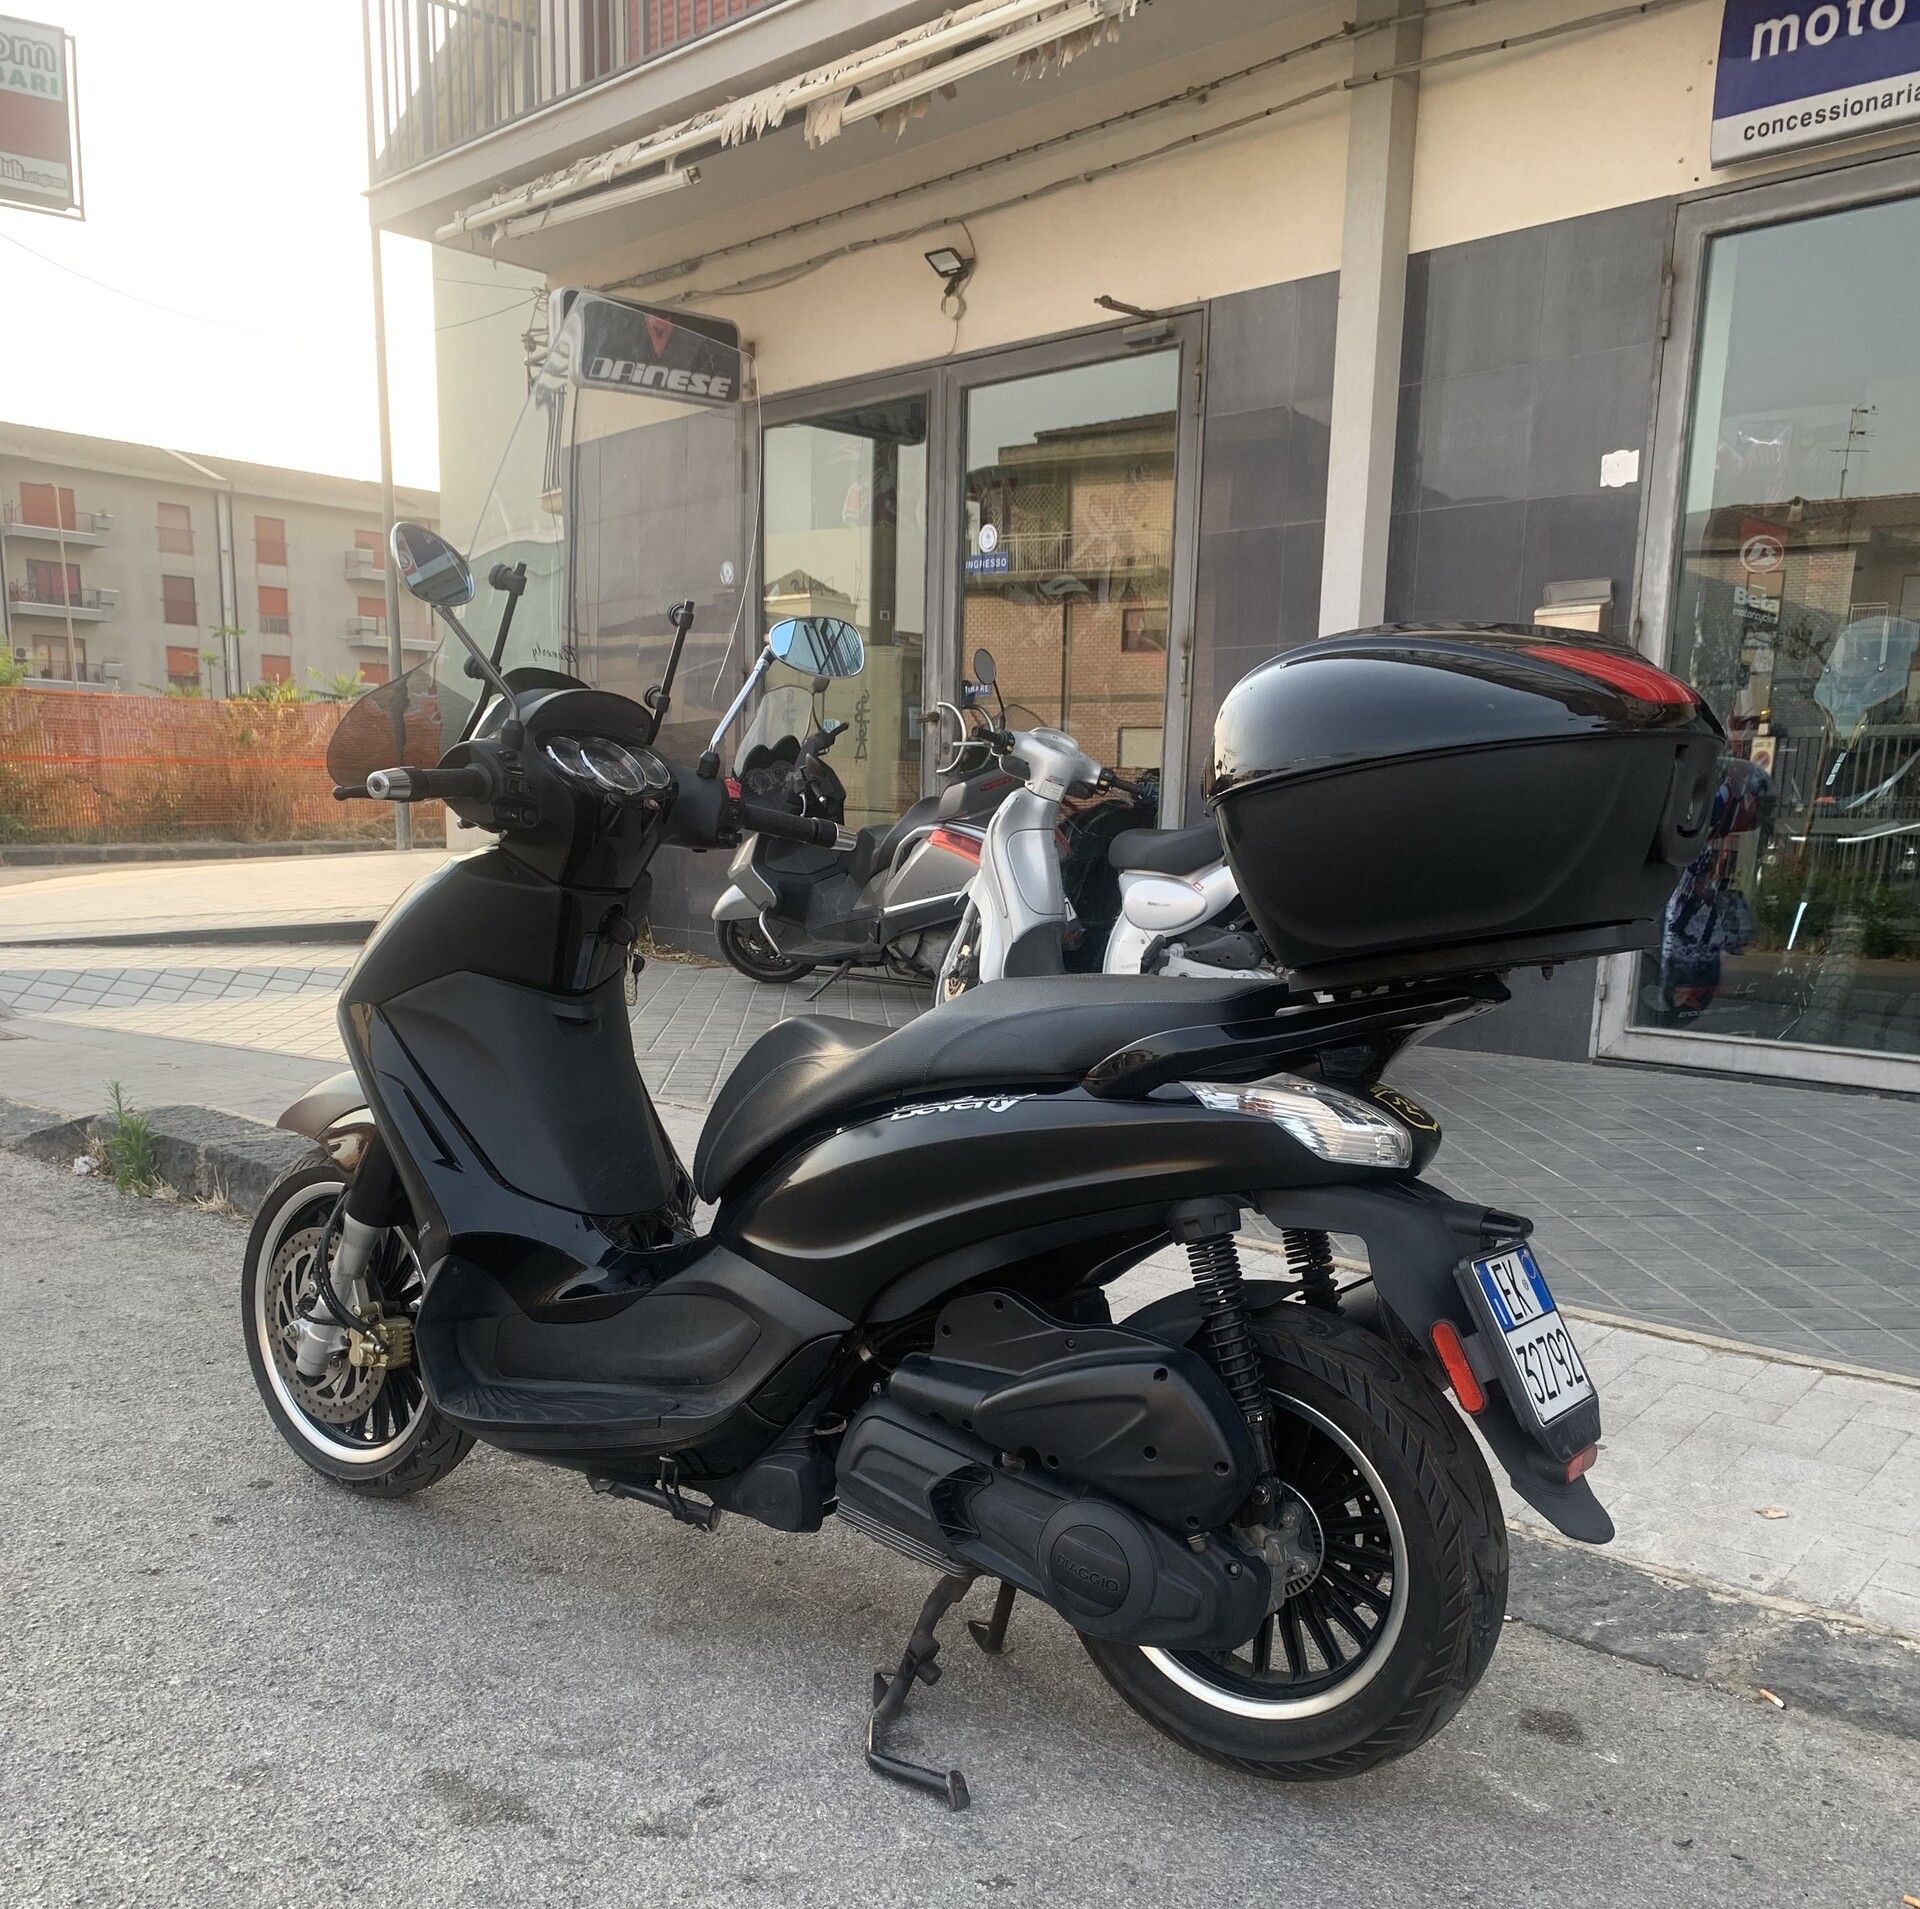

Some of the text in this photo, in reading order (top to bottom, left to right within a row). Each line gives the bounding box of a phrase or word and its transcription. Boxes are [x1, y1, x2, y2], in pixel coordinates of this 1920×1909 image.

[1751, 0, 1906, 61] moto
[0, 66, 58, 95] ARI
[965, 557, 1008, 569] INGRESSO
[1733, 586, 1780, 614] Beta
[1491, 1259, 1534, 1321] EK
[1515, 1328, 1585, 1405] 32792
[1057, 1552, 1119, 1593] PIAGGIO
